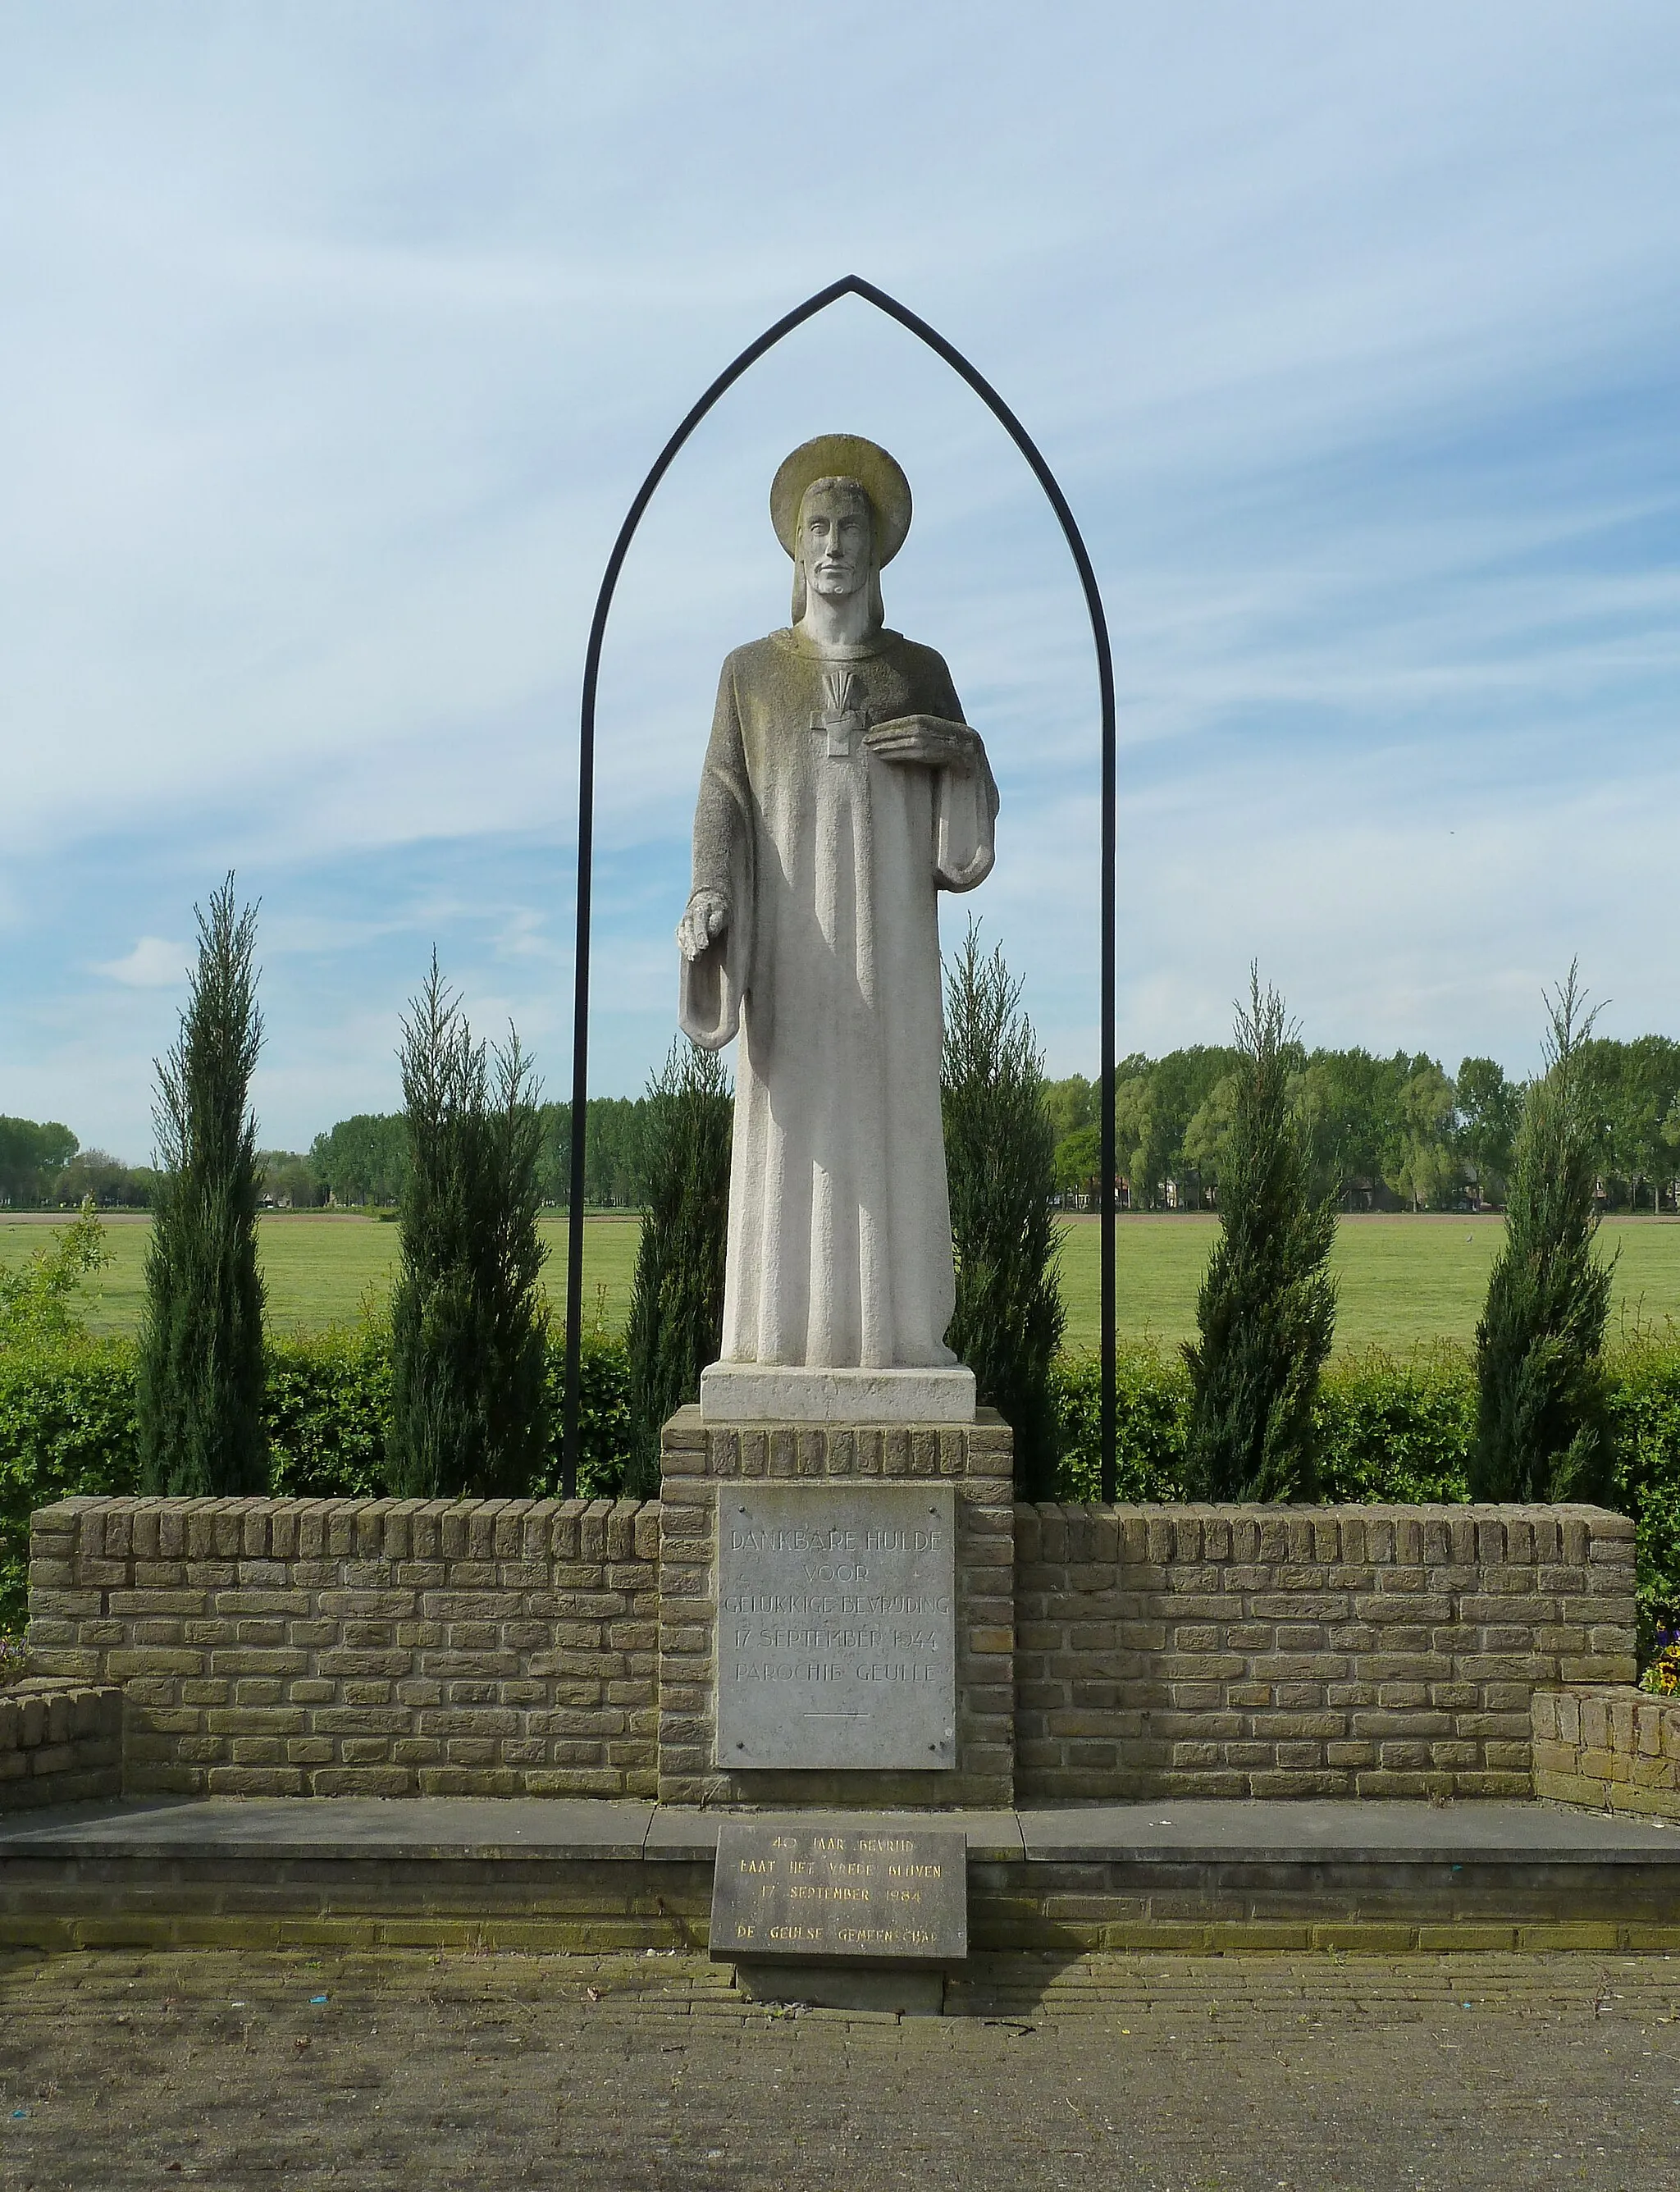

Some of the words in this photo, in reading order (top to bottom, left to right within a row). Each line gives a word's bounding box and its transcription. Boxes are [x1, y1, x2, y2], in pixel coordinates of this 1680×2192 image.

[731, 1531, 856, 1551] DANKBARE
[865, 1531, 943, 1552] HULDE
[801, 1564, 870, 1582] VOOR
[725, 1595, 834, 1614] GELUKKIGE
[734, 1629, 752, 1648] 17
[758, 1629, 882, 1648] SEPTEMBER
[893, 1629, 938, 1650] 1944
[736, 1663, 843, 1682] PAROCHIE
[856, 1663, 937, 1682] GEULLE
[772, 1836, 797, 1849] 40
[812, 1837, 845, 1851] JAAR
[740, 1859, 776, 1874] LAAT
[788, 1861, 815, 1875] HET
[829, 1862, 874, 1876] VREDE
[761, 1884, 776, 1897] 17
[790, 1886, 870, 1901] SEPTEMBER
[886, 1888, 921, 1903] 1984
[736, 1925, 756, 1939] DE
[769, 1926, 824, 1940] GEULSE
